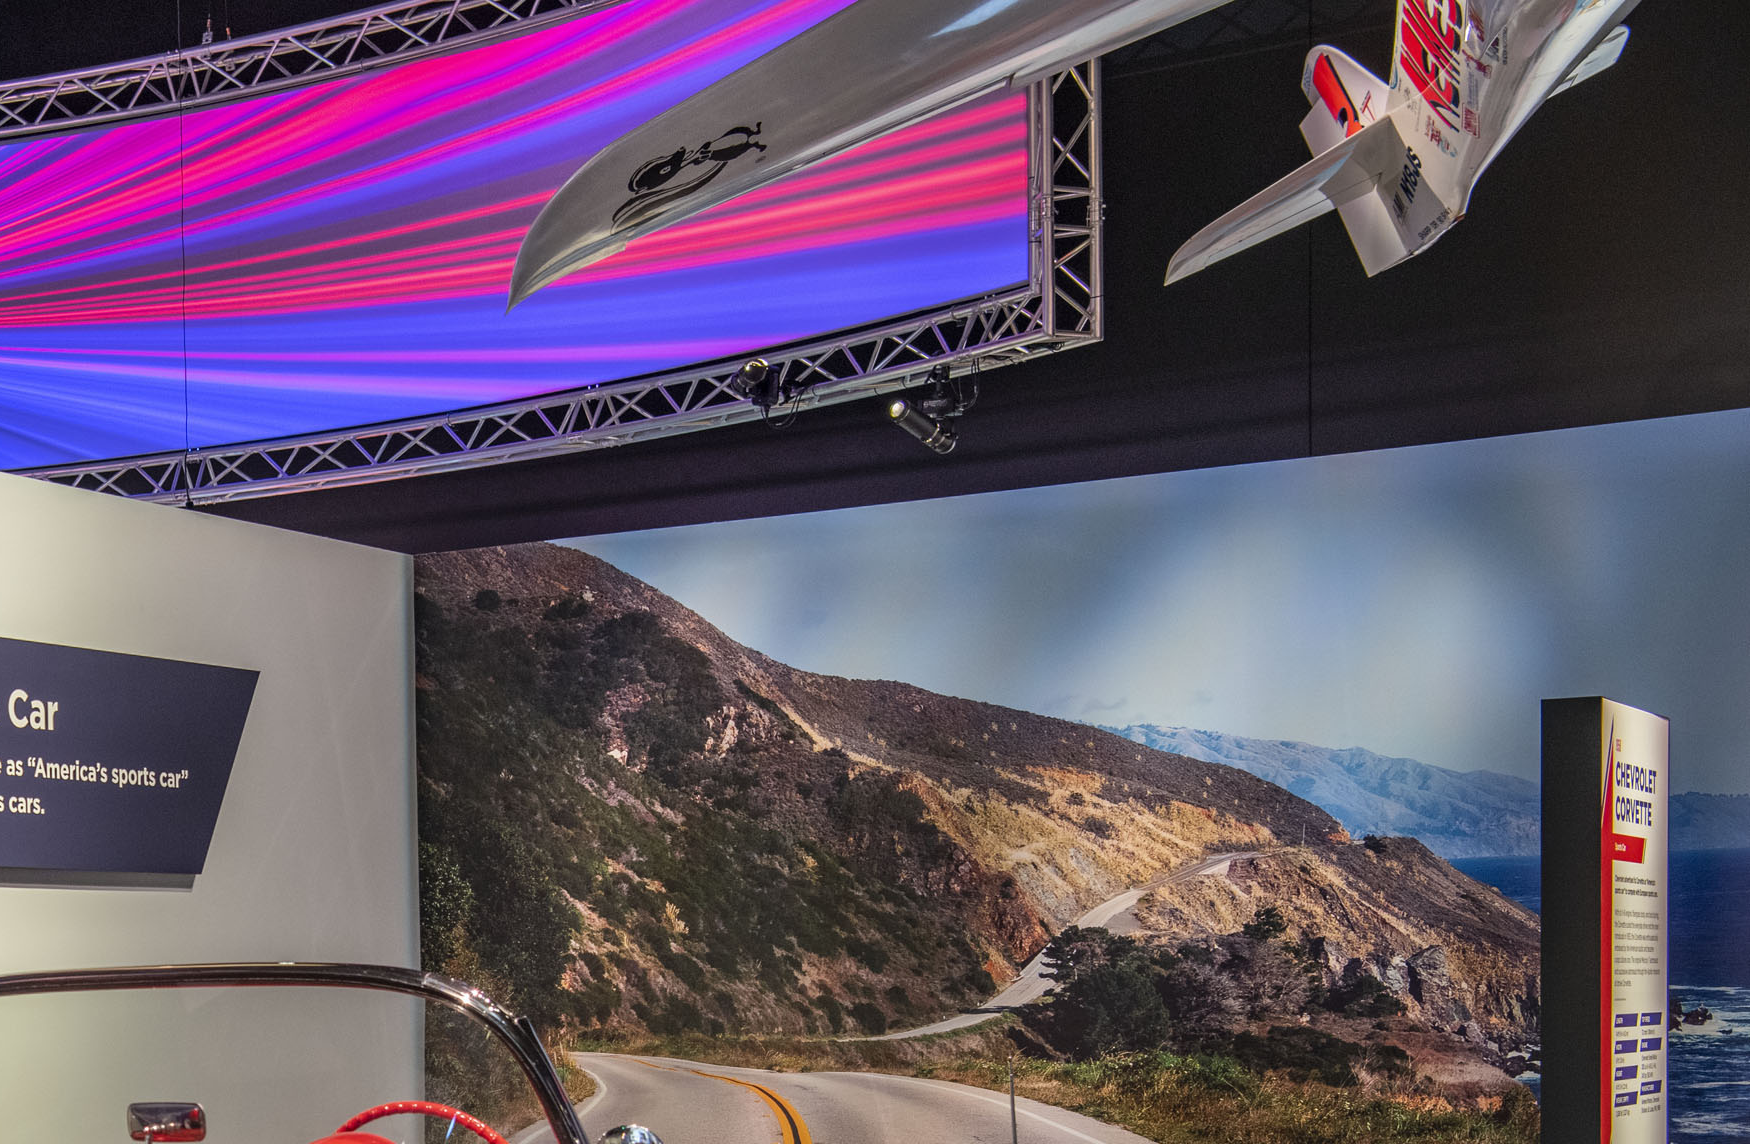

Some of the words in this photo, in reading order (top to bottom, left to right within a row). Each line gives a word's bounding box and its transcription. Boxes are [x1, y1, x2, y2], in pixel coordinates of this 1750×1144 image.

[8, 689, 59, 731] Car
[6, 758, 24, 777] as
[111, 767, 156, 789] sports
[1615, 761, 1657, 794] CHEVROLET
[8, 795, 46, 815] cars.
[1615, 796, 1652, 827] CORVETTE
